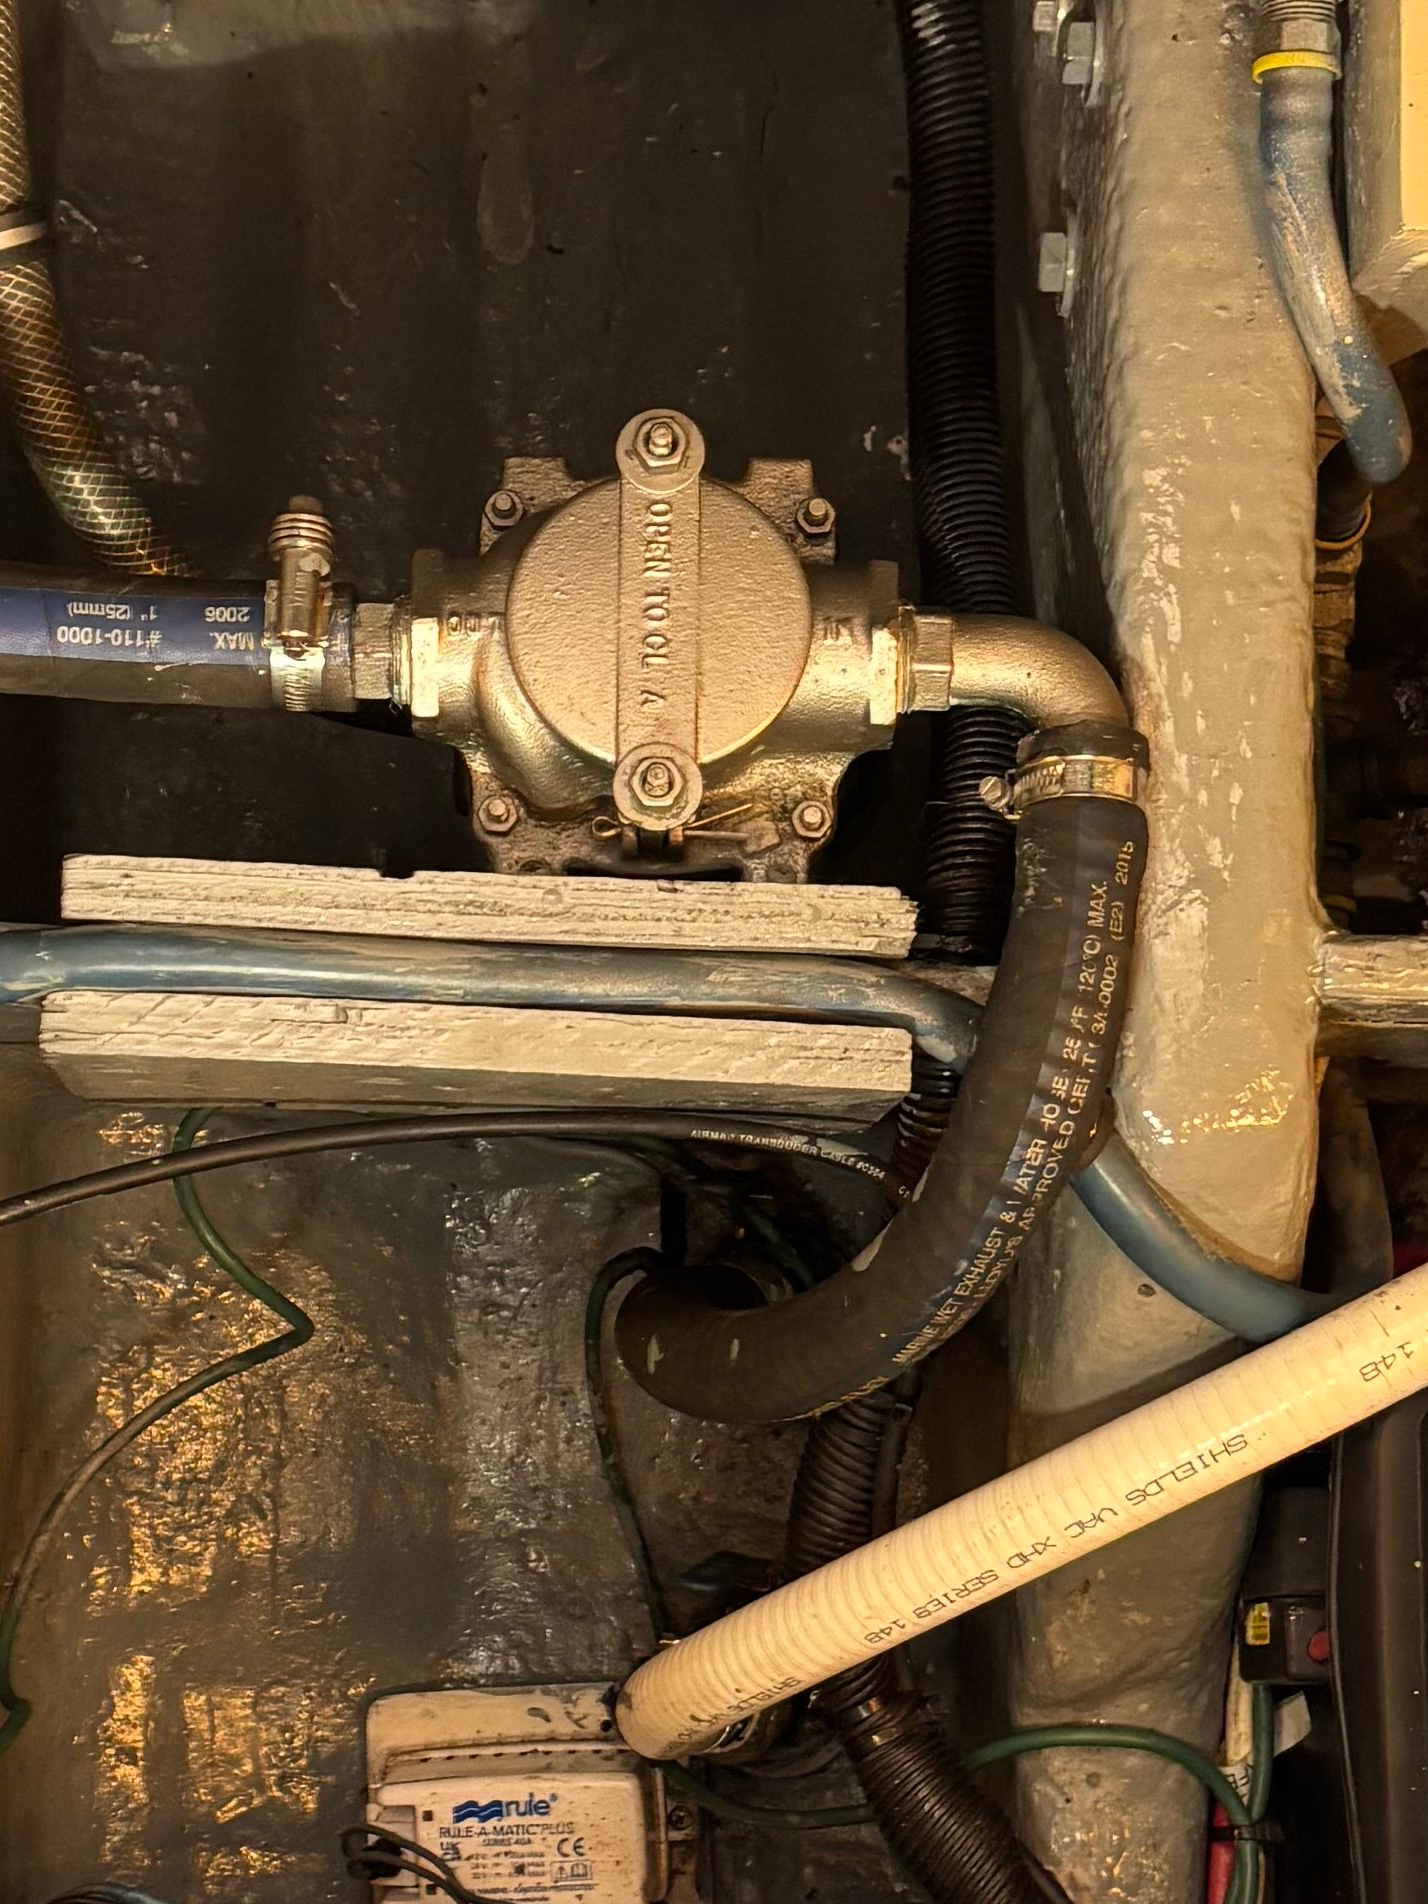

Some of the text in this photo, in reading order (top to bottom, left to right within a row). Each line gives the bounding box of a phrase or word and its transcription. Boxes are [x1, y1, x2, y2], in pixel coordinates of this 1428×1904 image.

[67, 602, 133, 620] (25mm)
[204, 606, 251, 623] 2006
[56, 625, 254, 652] #110-1000 MAX.
[1107, 901, 1130, 942] (E2)
[893, 1321, 936, 1366] MARINE
[929, 1294, 966, 1329] WET
[956, 1226, 1006, 1297] EXHAUST
[998, 1209, 1017, 1225] &
[1087, 877, 1110, 927] MAX.
[1358, 1337, 1415, 1385] 148
[866, 1431, 1247, 1648] SHIELDS VAC XHD SERIES 148
[556, 1837, 586, 1858] CE
